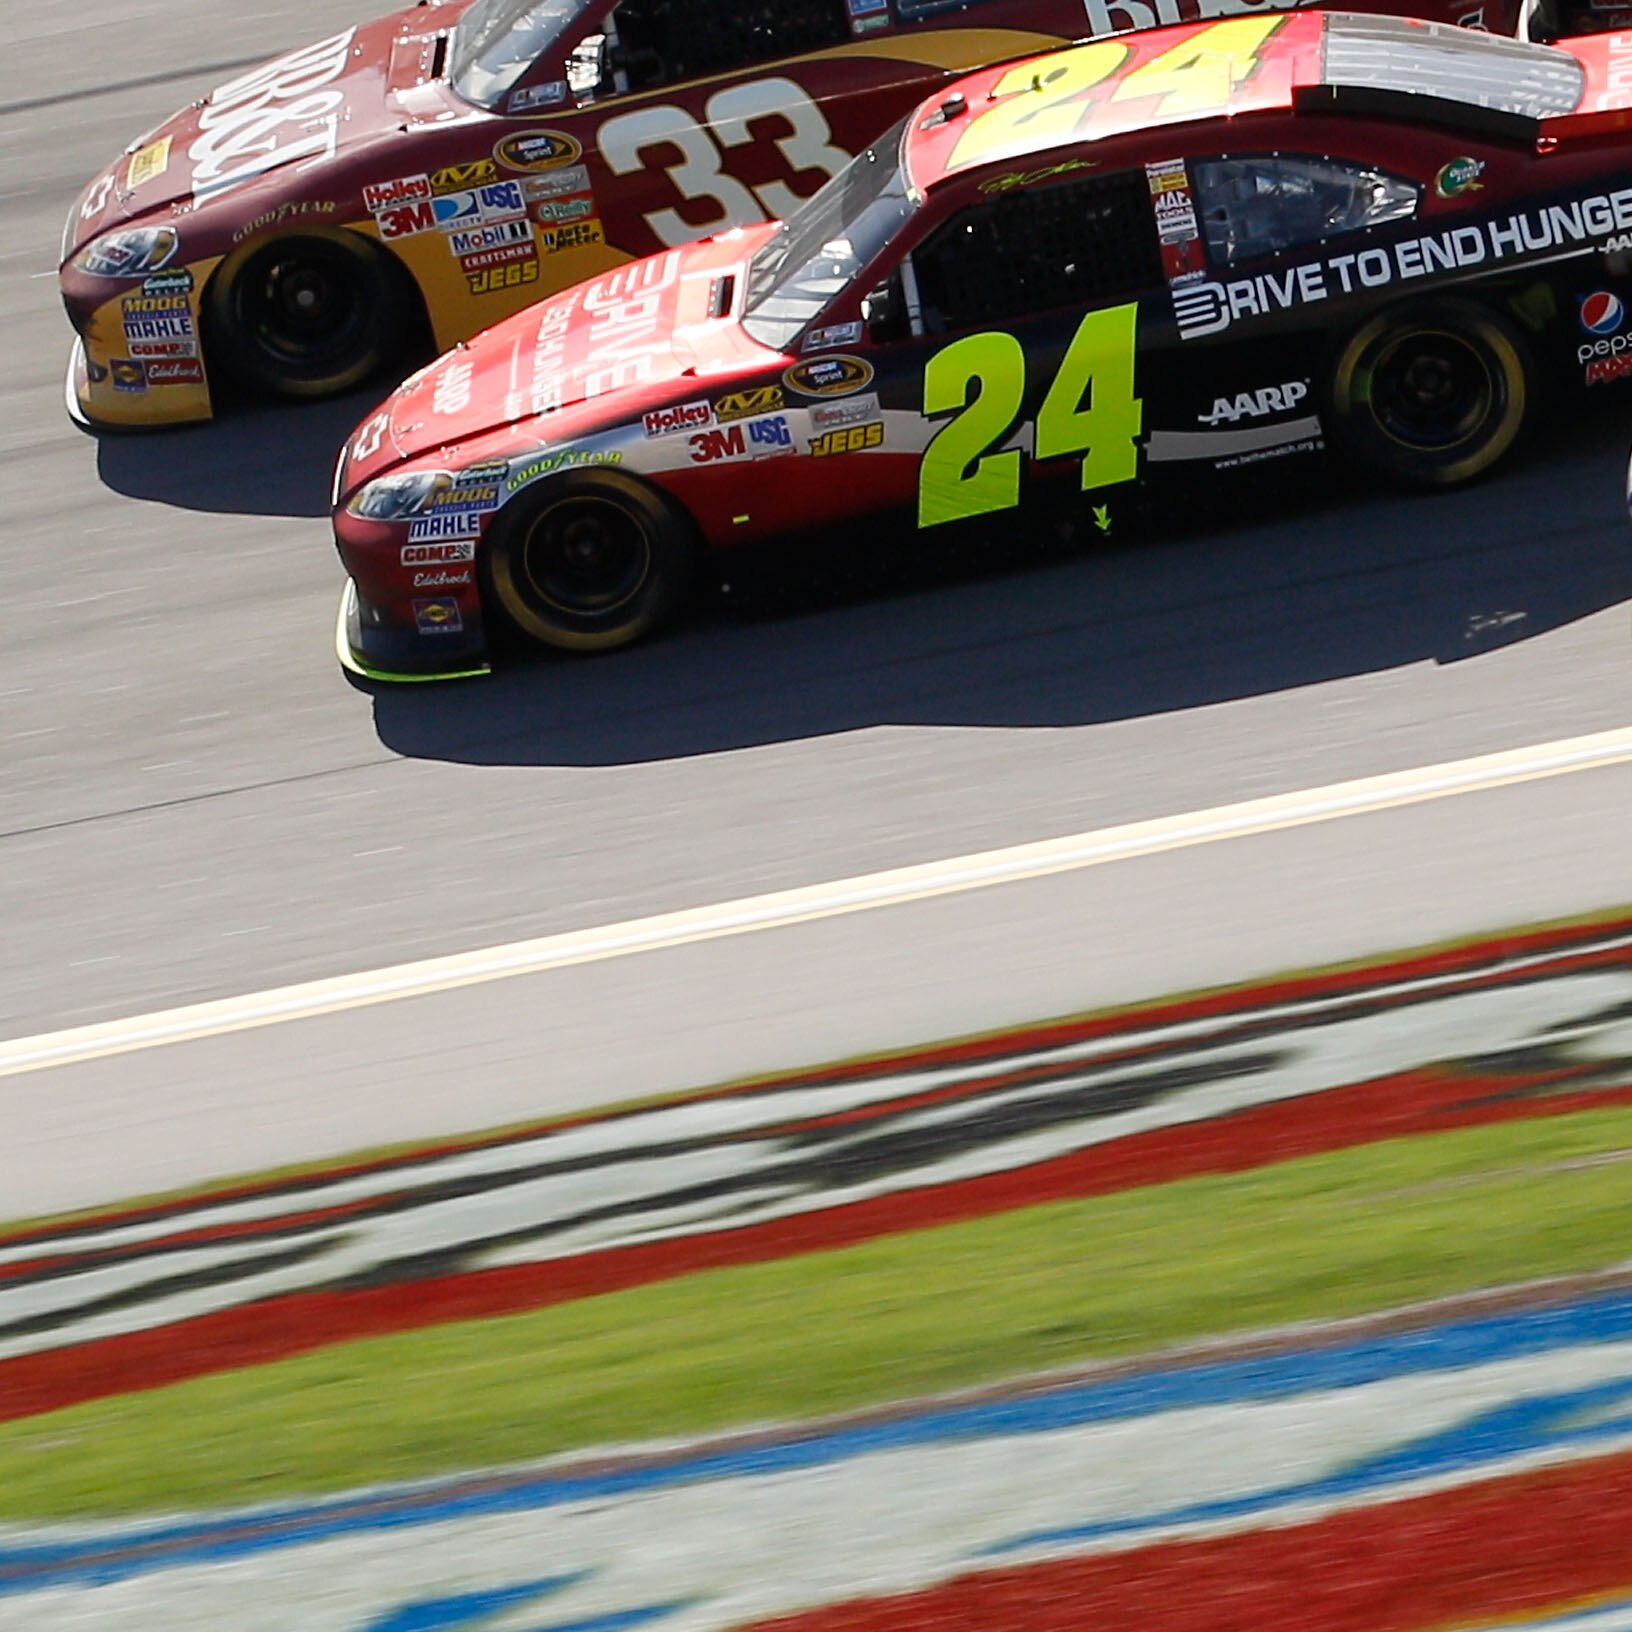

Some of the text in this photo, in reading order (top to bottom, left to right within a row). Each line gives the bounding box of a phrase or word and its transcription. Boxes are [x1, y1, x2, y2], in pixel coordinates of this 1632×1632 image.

[945, 13, 1291, 171] 24
[188, 24, 357, 212] BB&T
[598, 76, 856, 250] 33
[365, 179, 432, 204] Holley
[481, 181, 523, 211] USG
[1154, 190, 1193, 213] MAC
[231, 199, 336, 244] GOODYEAR
[380, 200, 435, 238] 3M
[556, 224, 591, 241] Auto
[452, 225, 506, 253] Mobil
[554, 232, 602, 253] Meter
[464, 244, 535, 268] CRAFTSMAN
[471, 260, 539, 294] JEGS
[1171, 259, 1329, 340] DRIVE
[1328, 247, 1392, 293] TO
[1394, 225, 1487, 279] END
[123, 297, 187, 312] MOOG
[124, 318, 193, 339] MAHLE
[130, 342, 181, 356] COMP
[812, 369, 844, 386] Sprint
[645, 402, 710, 428] Holley
[917, 301, 1143, 530] 24
[1197, 380, 1312, 426] AARP
[688, 425, 746, 463] 3M
[748, 416, 792, 446] USG
[808, 422, 884, 457] JEGS
[506, 449, 624, 492] GOODYEAR
[433, 488, 497, 505] MOOG
[411, 513, 479, 538] MAHLE
[404, 545, 456, 562] COMP
[414, 572, 472, 588] Edelbrock
